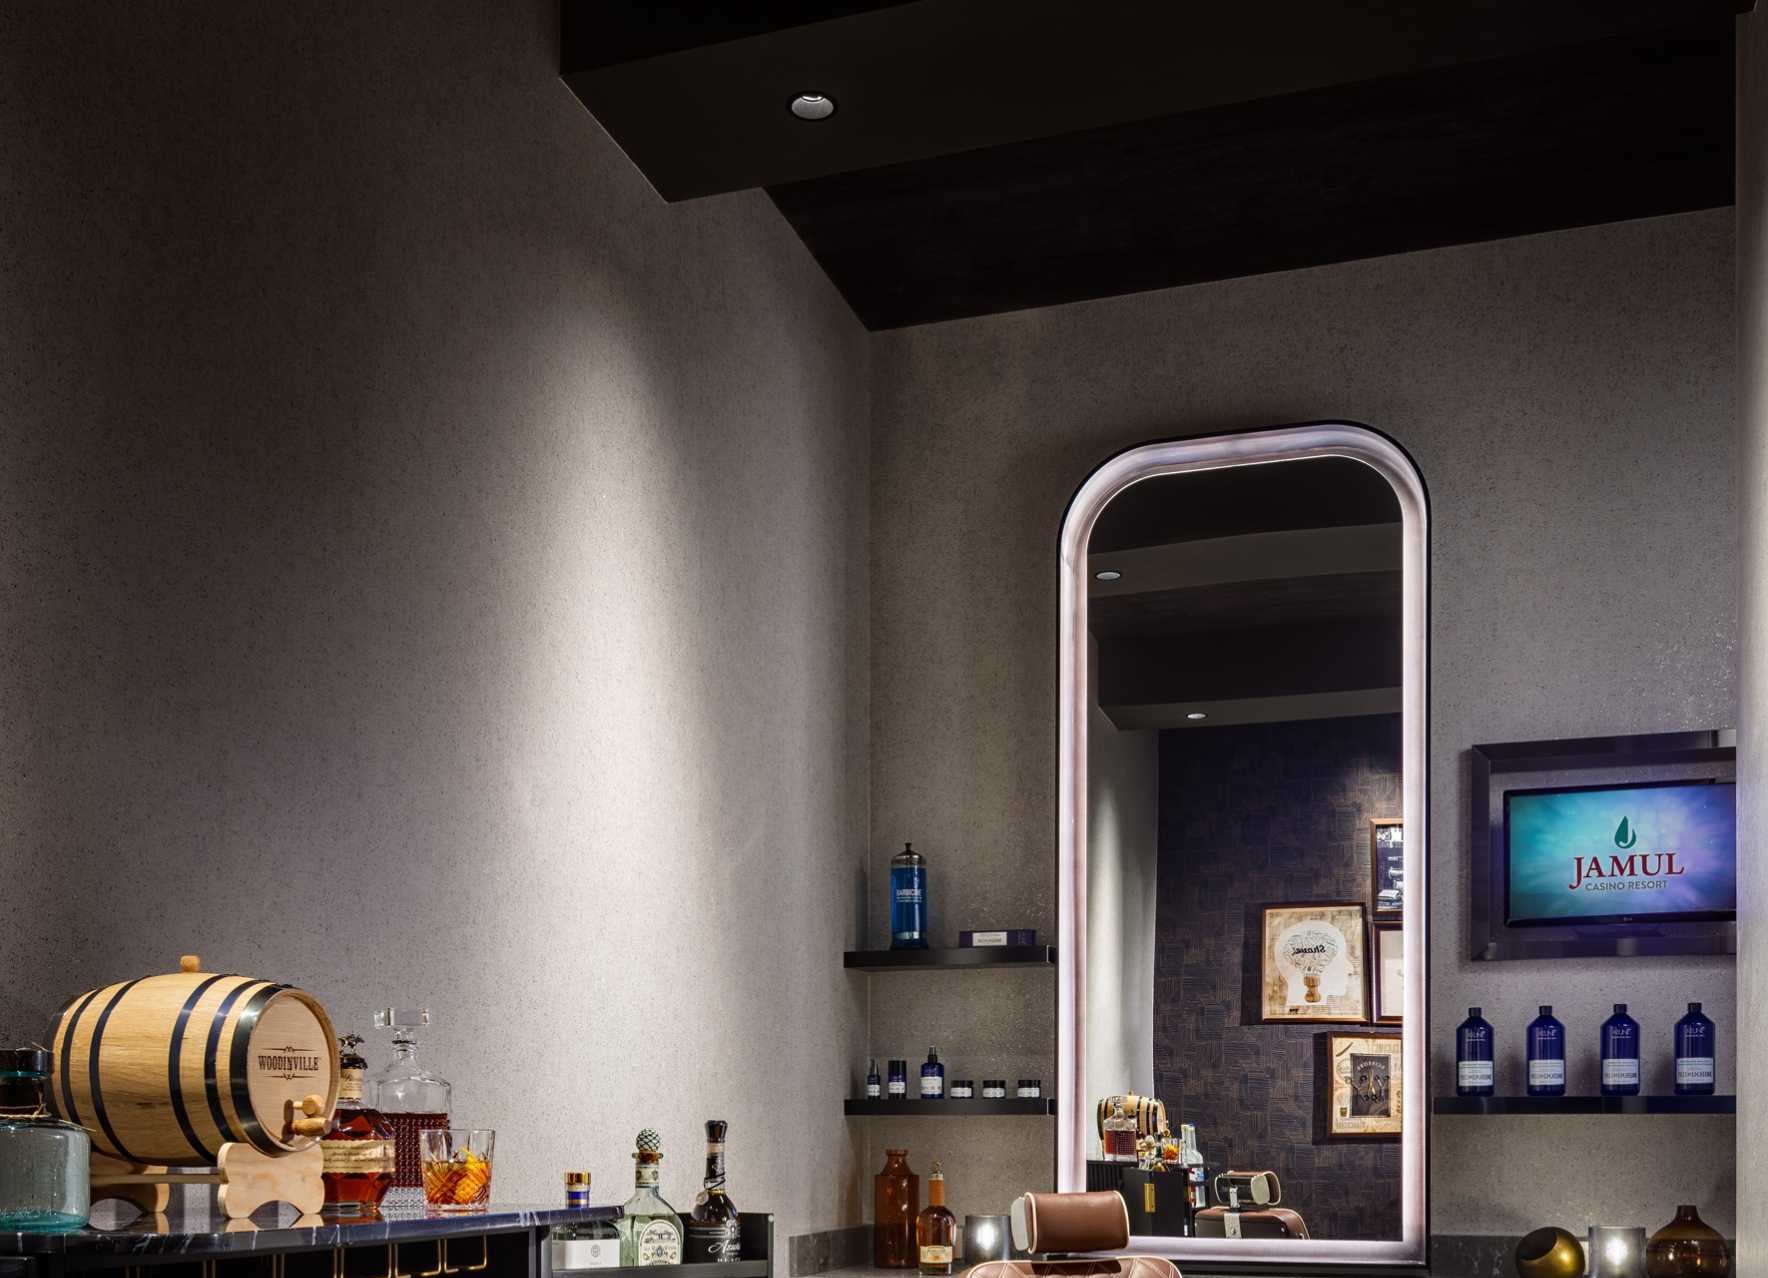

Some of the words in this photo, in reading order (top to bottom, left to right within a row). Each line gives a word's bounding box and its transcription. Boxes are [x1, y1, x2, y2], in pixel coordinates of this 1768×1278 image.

[1569, 852, 1685, 890] JAMUL
[1585, 882, 1625, 891] CASINO
[1628, 880, 1668, 890] RESORT
[257, 1055, 320, 1071] WOODINVILLE
